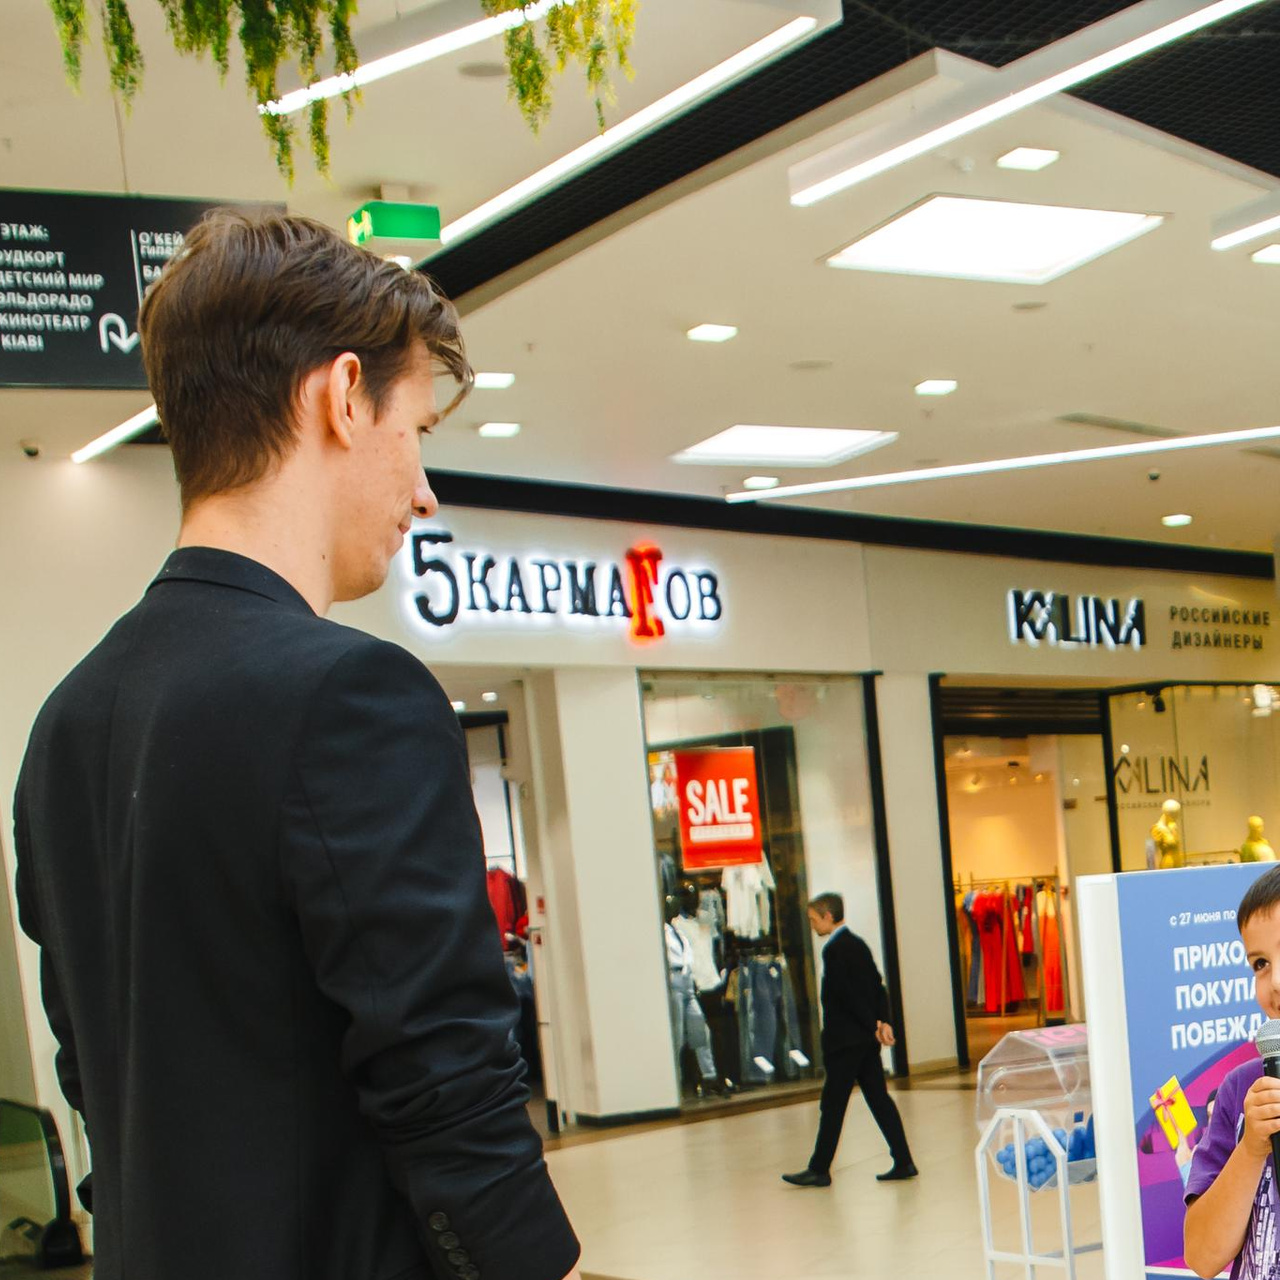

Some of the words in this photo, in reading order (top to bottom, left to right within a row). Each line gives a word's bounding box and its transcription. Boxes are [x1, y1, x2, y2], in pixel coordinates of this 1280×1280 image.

[68, 273, 104, 290] МИР
[0, 313, 91, 331] КИНОТЕАТР
[1169, 605, 1271, 627] РОССИЙСКИЕ
[1171, 630, 1264, 650] ДИЗАЙНЕРЫ
[685, 778, 753, 826] SALE
[1169, 915, 1178, 926] с
[1179, 912, 1192, 925] 27
[1193, 913, 1222, 924] июня
[1171, 1013, 1270, 1050] ПОБЕЖД
